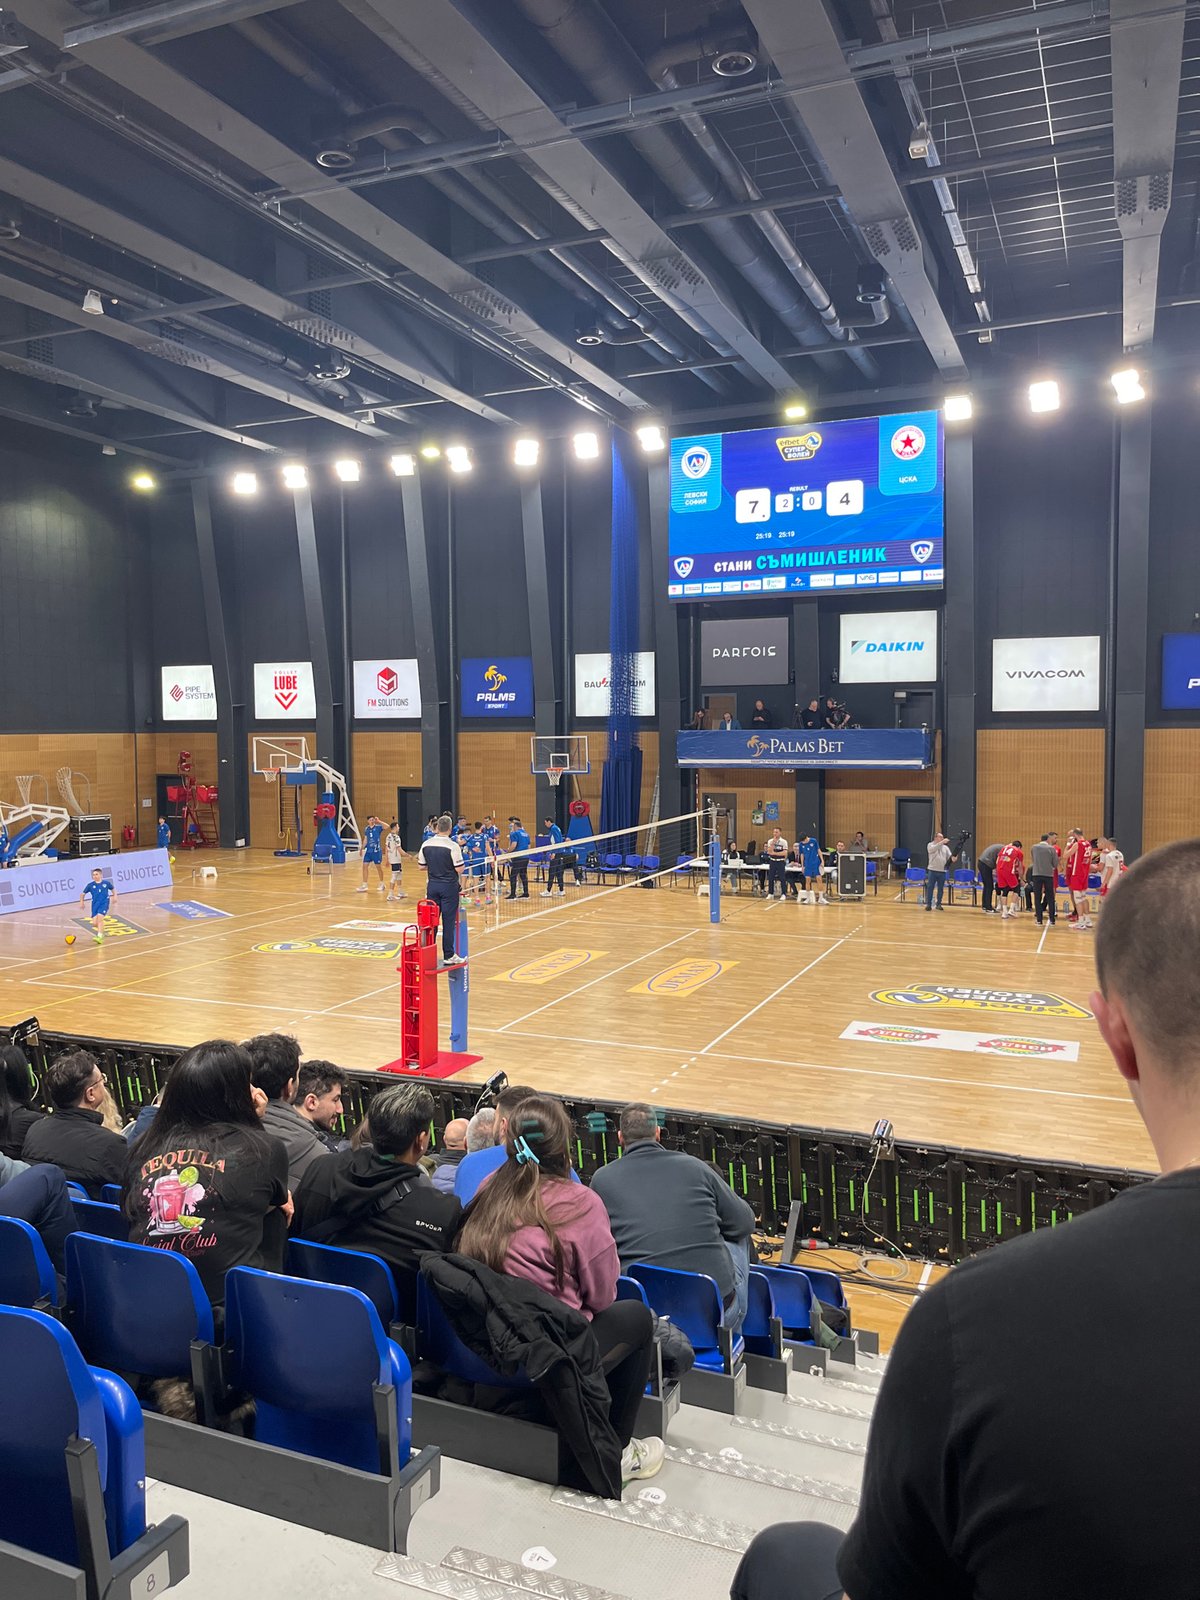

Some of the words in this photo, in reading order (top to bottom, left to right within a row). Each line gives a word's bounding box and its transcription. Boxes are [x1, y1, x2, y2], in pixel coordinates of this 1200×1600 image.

[898, 475, 918, 484] ЦСКА
[684, 491, 708, 499] ЛЕВСКИ
[748, 500, 759, 514] 7
[782, 499, 789, 508] 2
[808, 497, 815, 506] 0
[839, 492, 851, 505] 4
[755, 532, 772, 540] 25:19
[778, 530, 795, 538] 25:19
[713, 560, 753, 573] СТАНИ
[756, 547, 887, 570] СЪМИШЛЕНИК
[712, 646, 777, 658] PARFOIS
[865, 641, 925, 653] DAIKIN
[1005, 669, 1086, 679] VIVACOM
[274, 675, 298, 690] LUBE
[185, 692, 214, 700] SYSTEM
[476, 692, 516, 702] PALMS
[367, 698, 377, 707] FM
[377, 698, 409, 707] SOLUTIONS
[769, 738, 815, 754] PALMS
[817, 738, 845, 754] BET
[1002, 846, 1014, 856] 14
[18, 878, 76, 898] SUNOTEC
[116, 864, 165, 882] SUNOTEC
[657, 963, 713, 990] DEMAX
[936, 986, 1033, 999] ВОЛЕЙ
[953, 993, 1046, 1005] СУПЕР
[140, 1149, 226, 1180] TEQUILA
[179, 1232, 217, 1251] Club
[146, 1573, 156, 1593] 8
